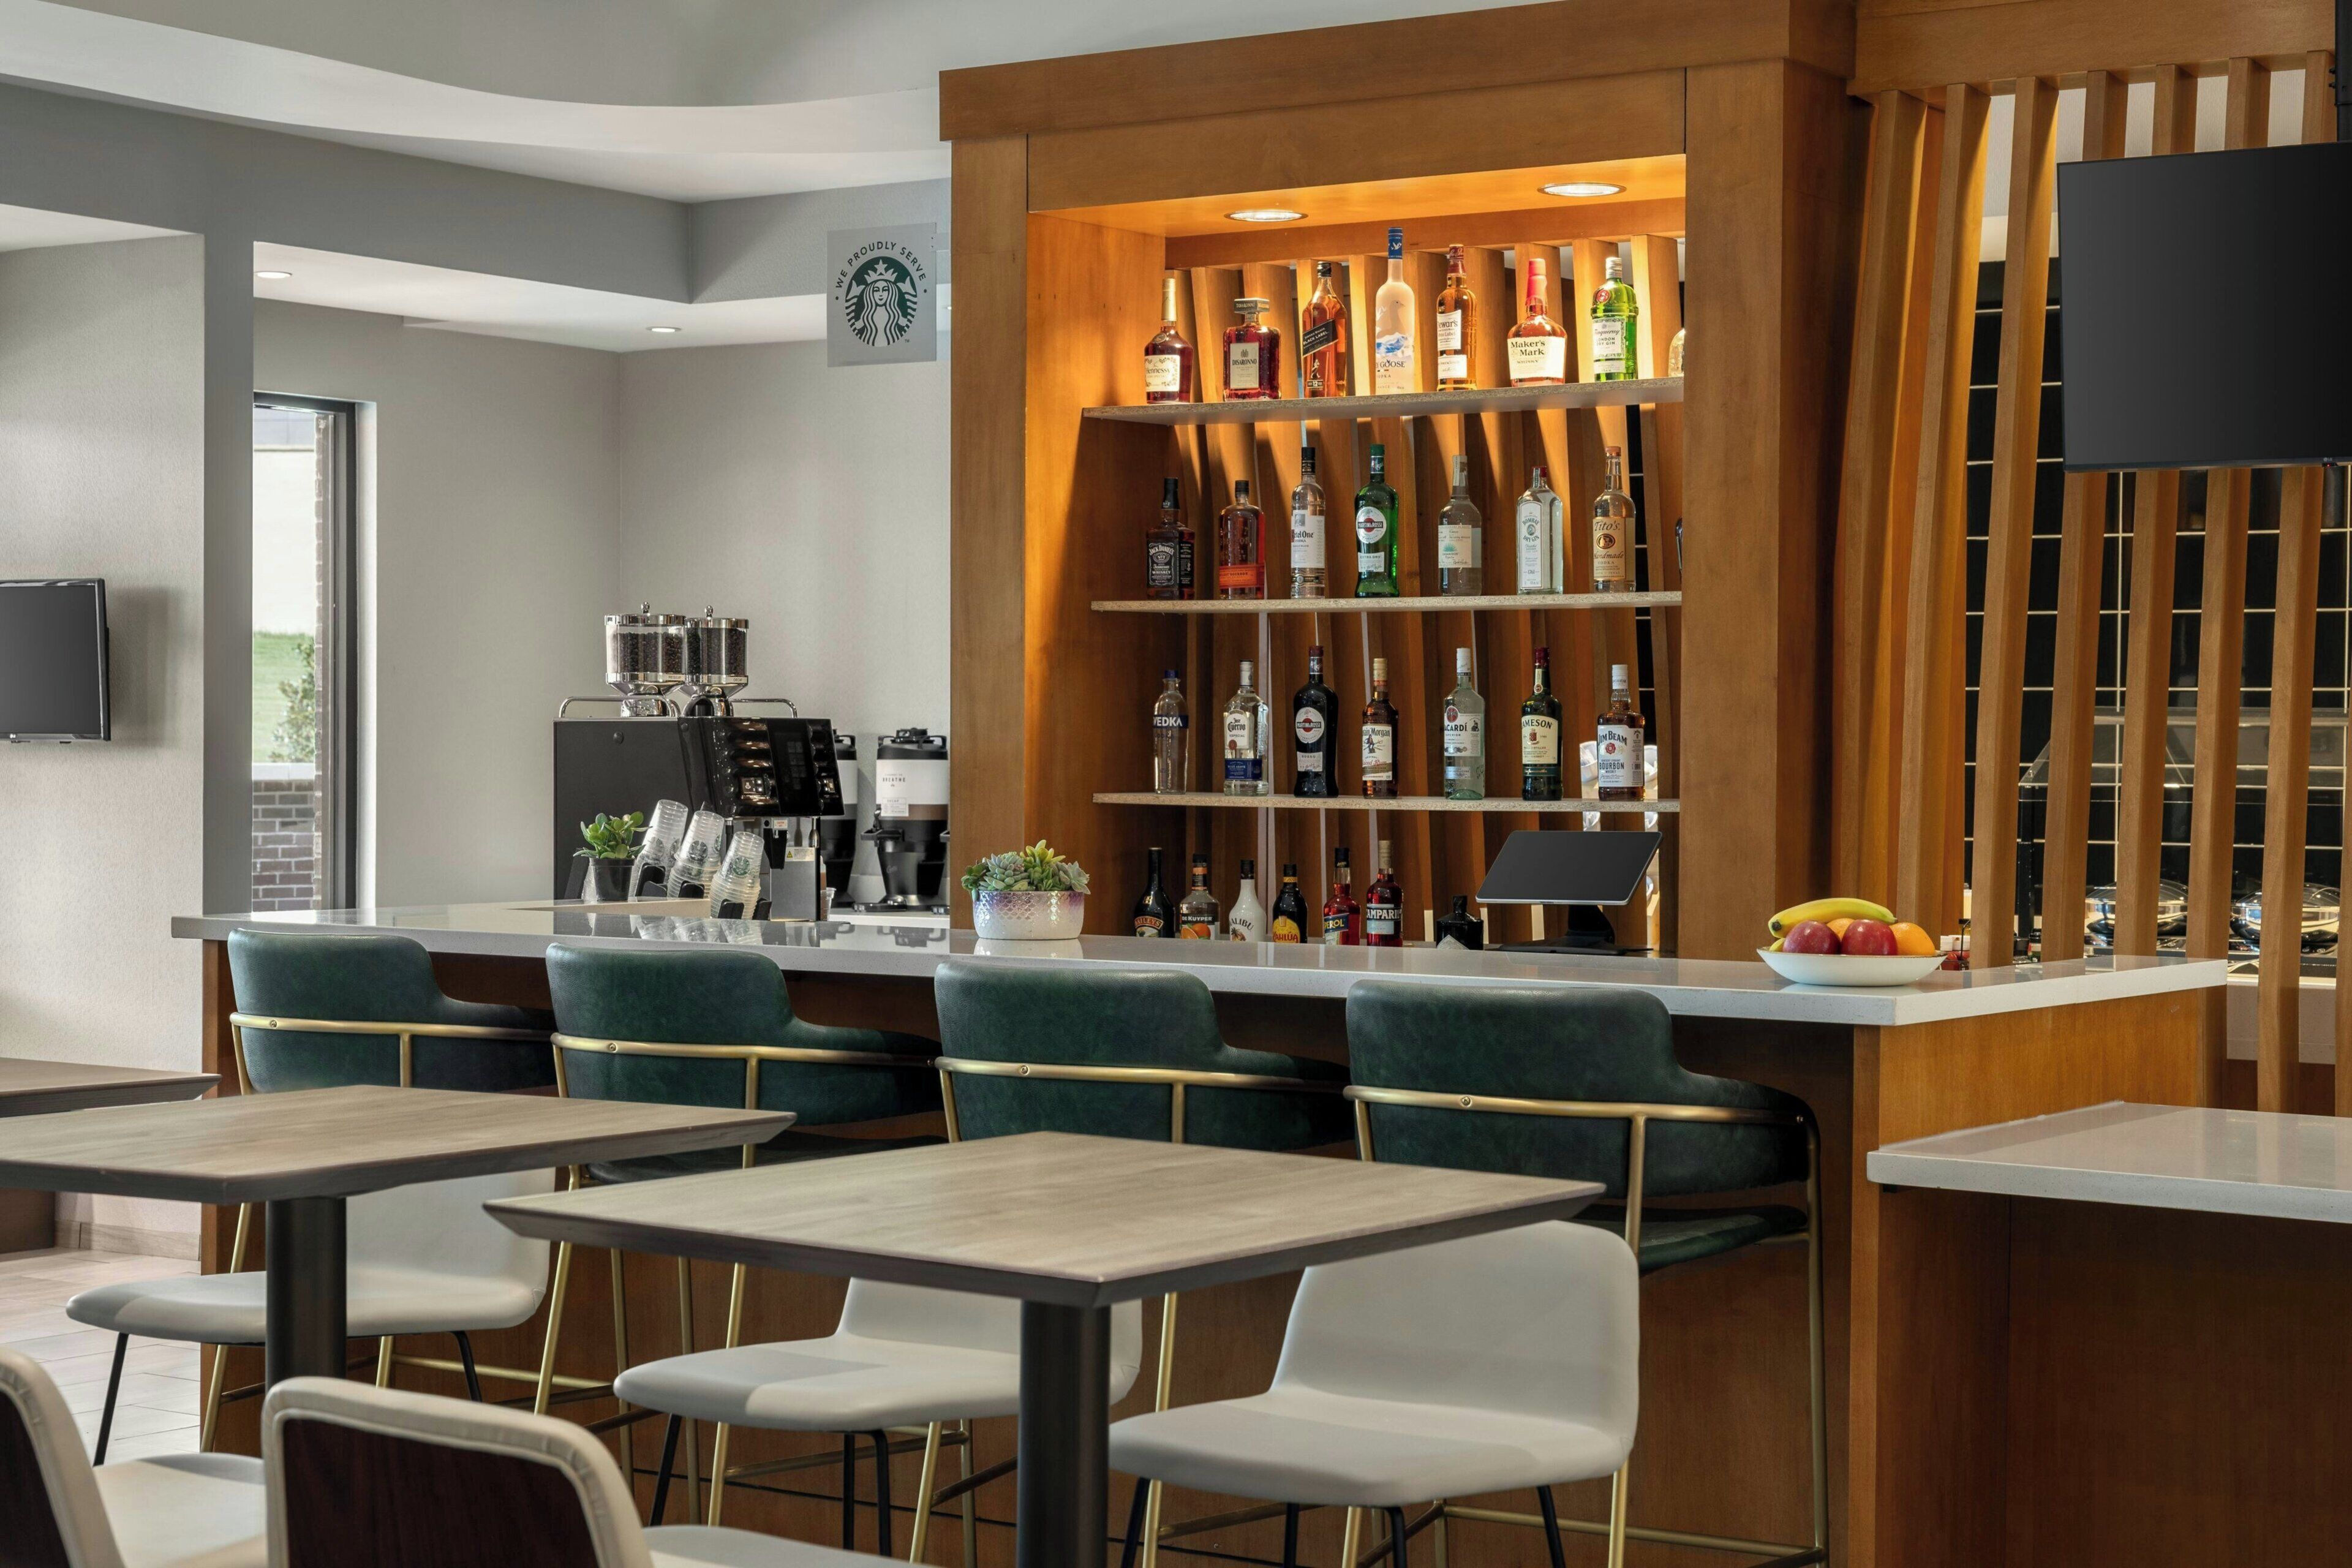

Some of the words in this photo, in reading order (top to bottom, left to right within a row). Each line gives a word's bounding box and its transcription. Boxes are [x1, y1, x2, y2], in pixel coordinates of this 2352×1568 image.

[835, 270, 848, 289] WE
[848, 241, 897, 266] PROUDLY
[900, 247, 926, 282] SERVE
[1438, 320, 1458, 329] ewar's
[1303, 337, 1316, 345] BLACK
[1316, 331, 1328, 339] LABEL
[1511, 340, 1545, 349] Maker's
[1380, 359, 1405, 368] GOOSE
[1302, 530, 1313, 538] One
[1149, 546, 1159, 556] JACK
[1158, 545, 1174, 554] DANIEL'S
[1153, 717, 1183, 727] VEDKA
[1227, 722, 1246, 732] Cuervo
[1444, 722, 1468, 732] ACARDÍ
[1523, 718, 1552, 729] AMESON
[1371, 728, 1390, 738] Morgan
[1599, 733, 1608, 746] JIM
[1608, 730, 1627, 746] BEAM
[1599, 761, 1625, 770] BOURBON
[1366, 909, 1397, 919] AMPARI
[1324, 919, 1344, 930] PEROL
